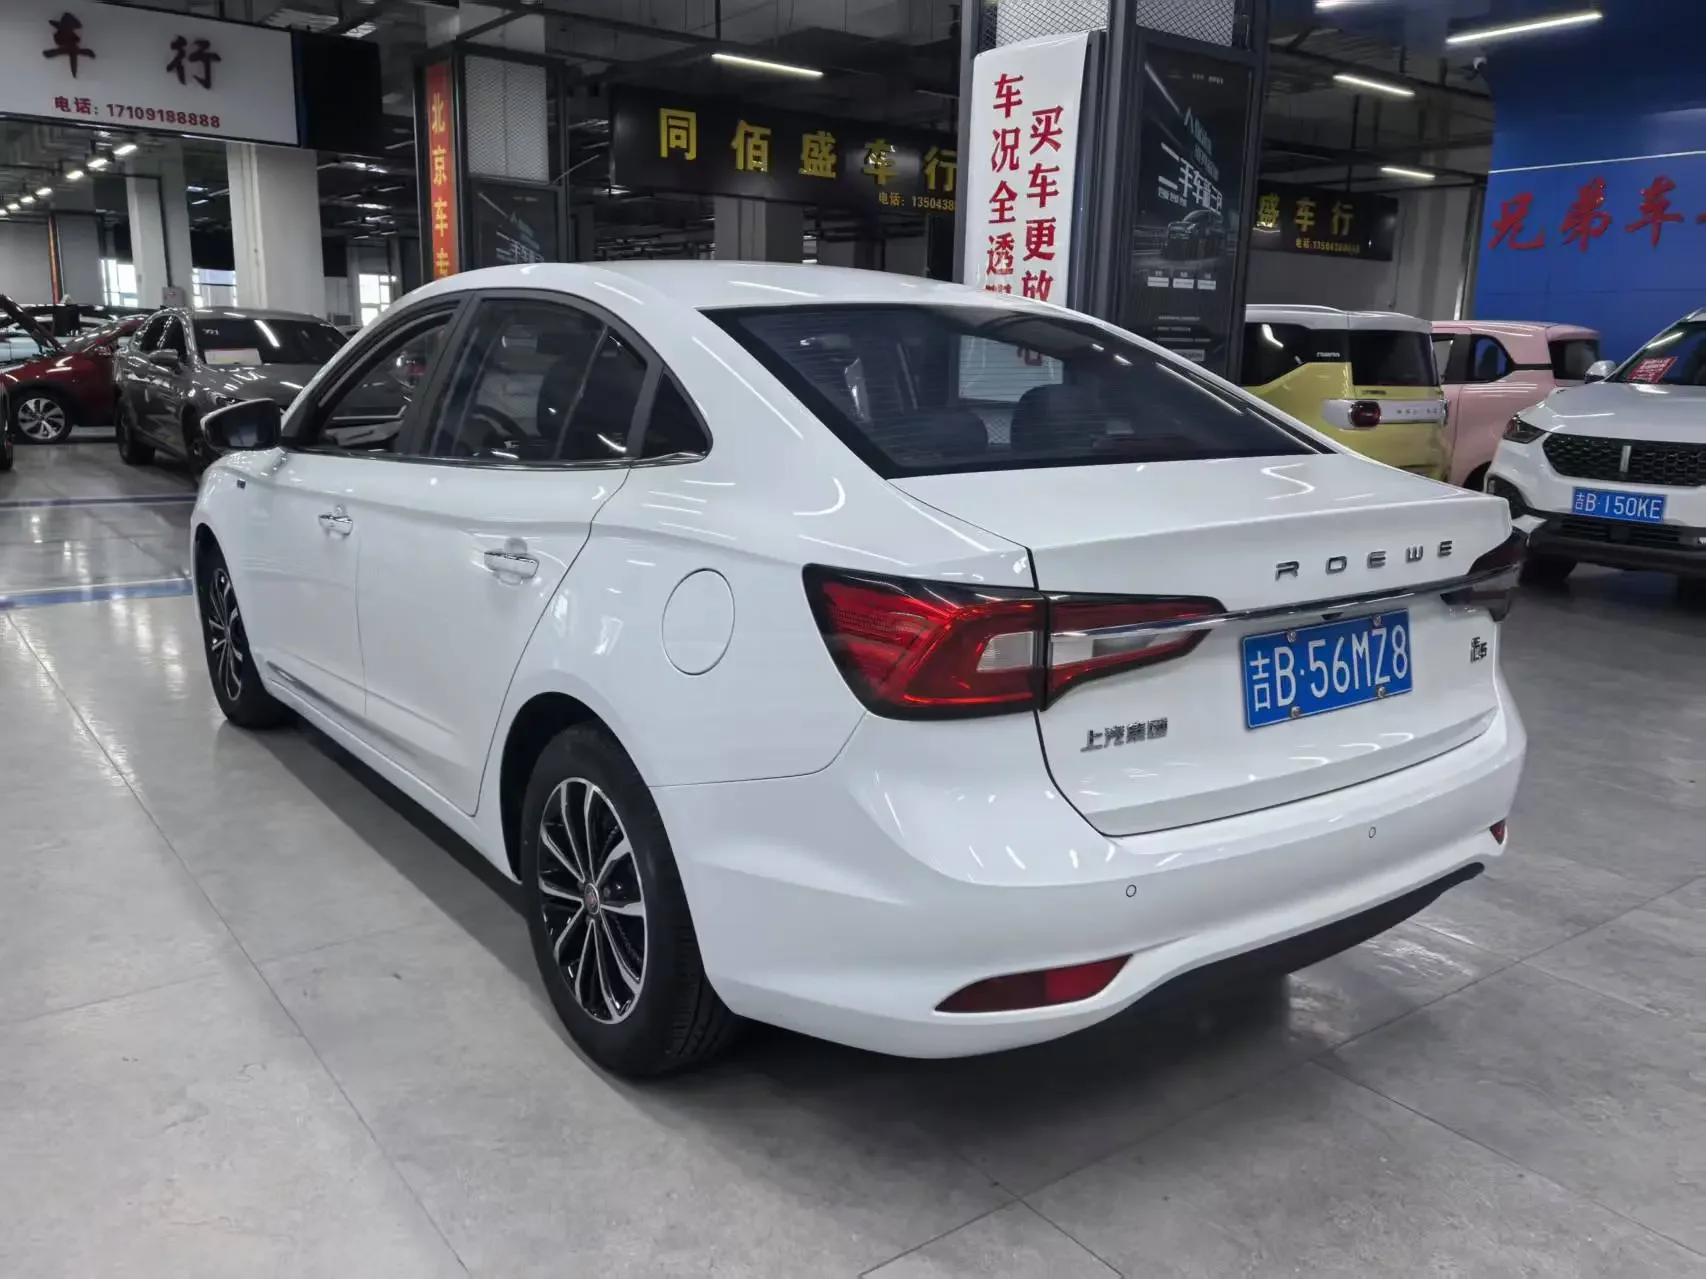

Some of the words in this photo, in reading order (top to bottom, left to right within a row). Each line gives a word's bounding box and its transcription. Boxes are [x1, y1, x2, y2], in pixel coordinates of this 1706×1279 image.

[42, 11, 222, 90] 车行
[659, 107, 957, 192] 同佰盛车行
[1488, 175, 1706, 253] 兄弟车
[1275, 540, 1453, 581] ROEWE
[1250, 624, 1409, 712] 吉B·56MZ8
